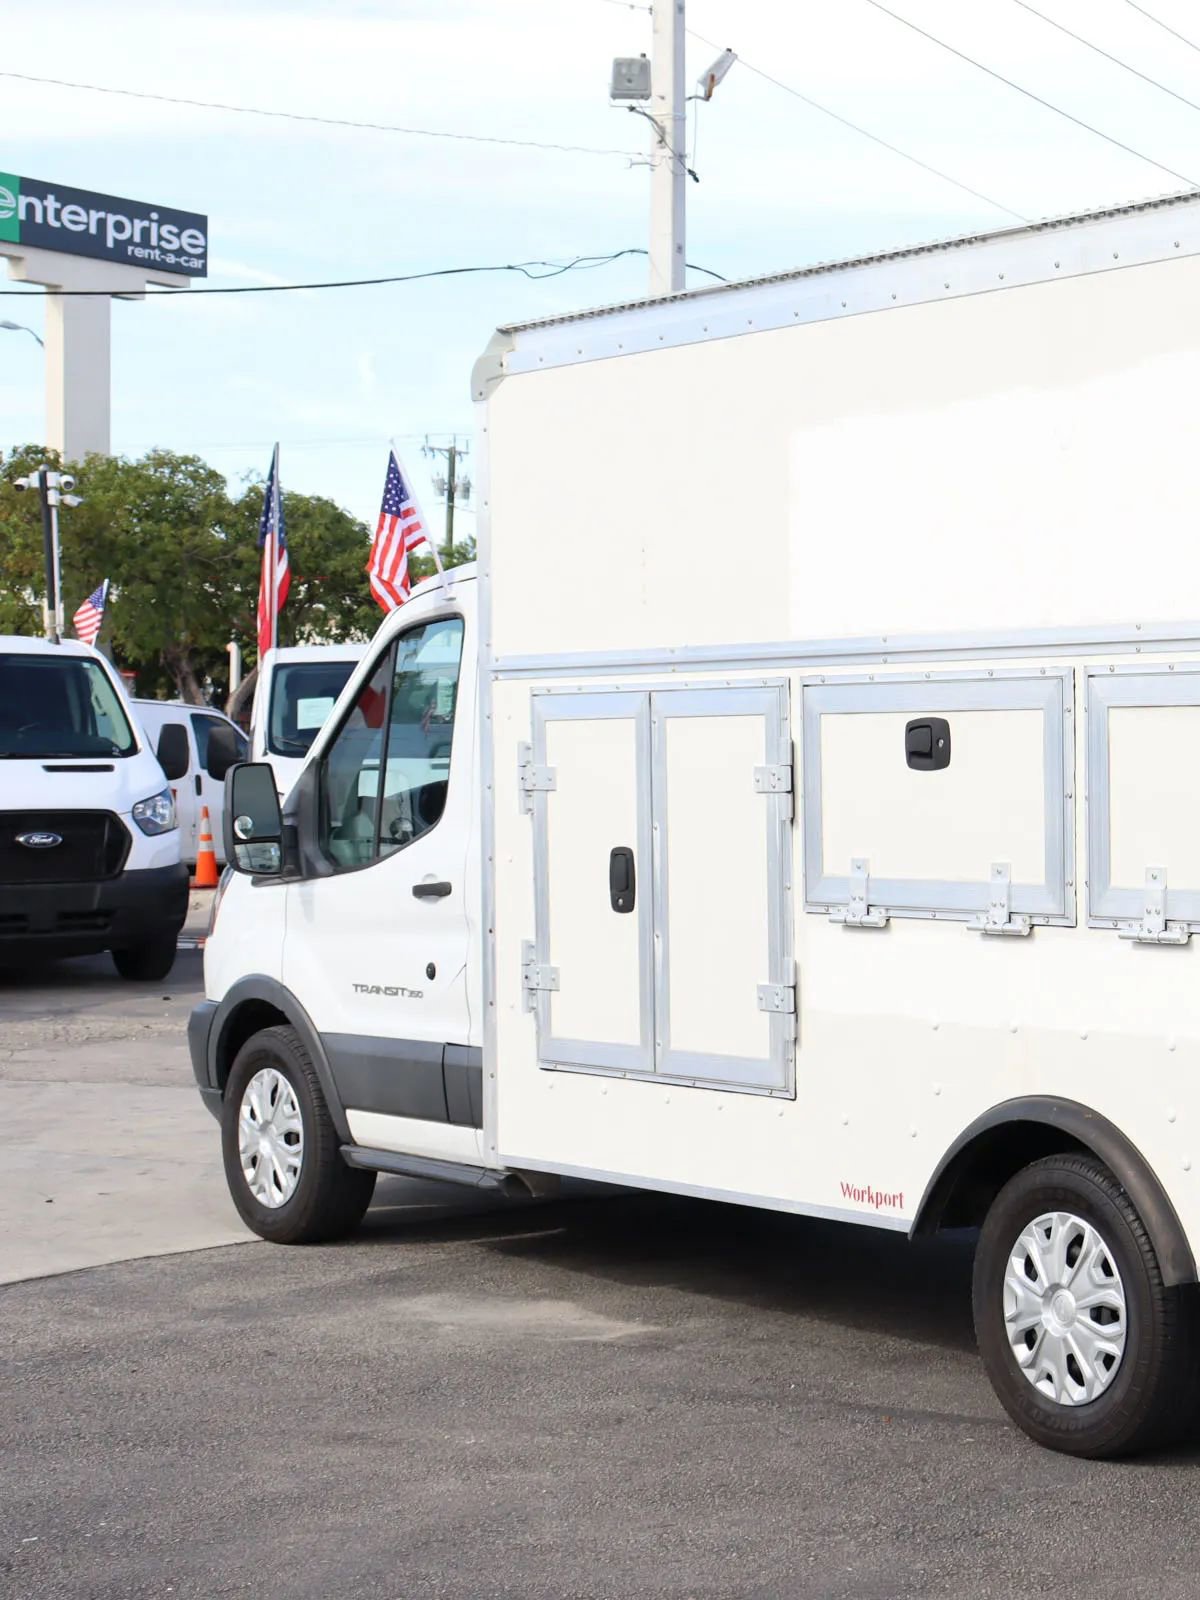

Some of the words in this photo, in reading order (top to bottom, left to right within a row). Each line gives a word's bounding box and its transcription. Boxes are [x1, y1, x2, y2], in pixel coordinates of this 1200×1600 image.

[128, 246, 205, 269] rent-a-car
[352, 983, 407, 997] TRANSIT
[840, 1181, 904, 1209] Workport
